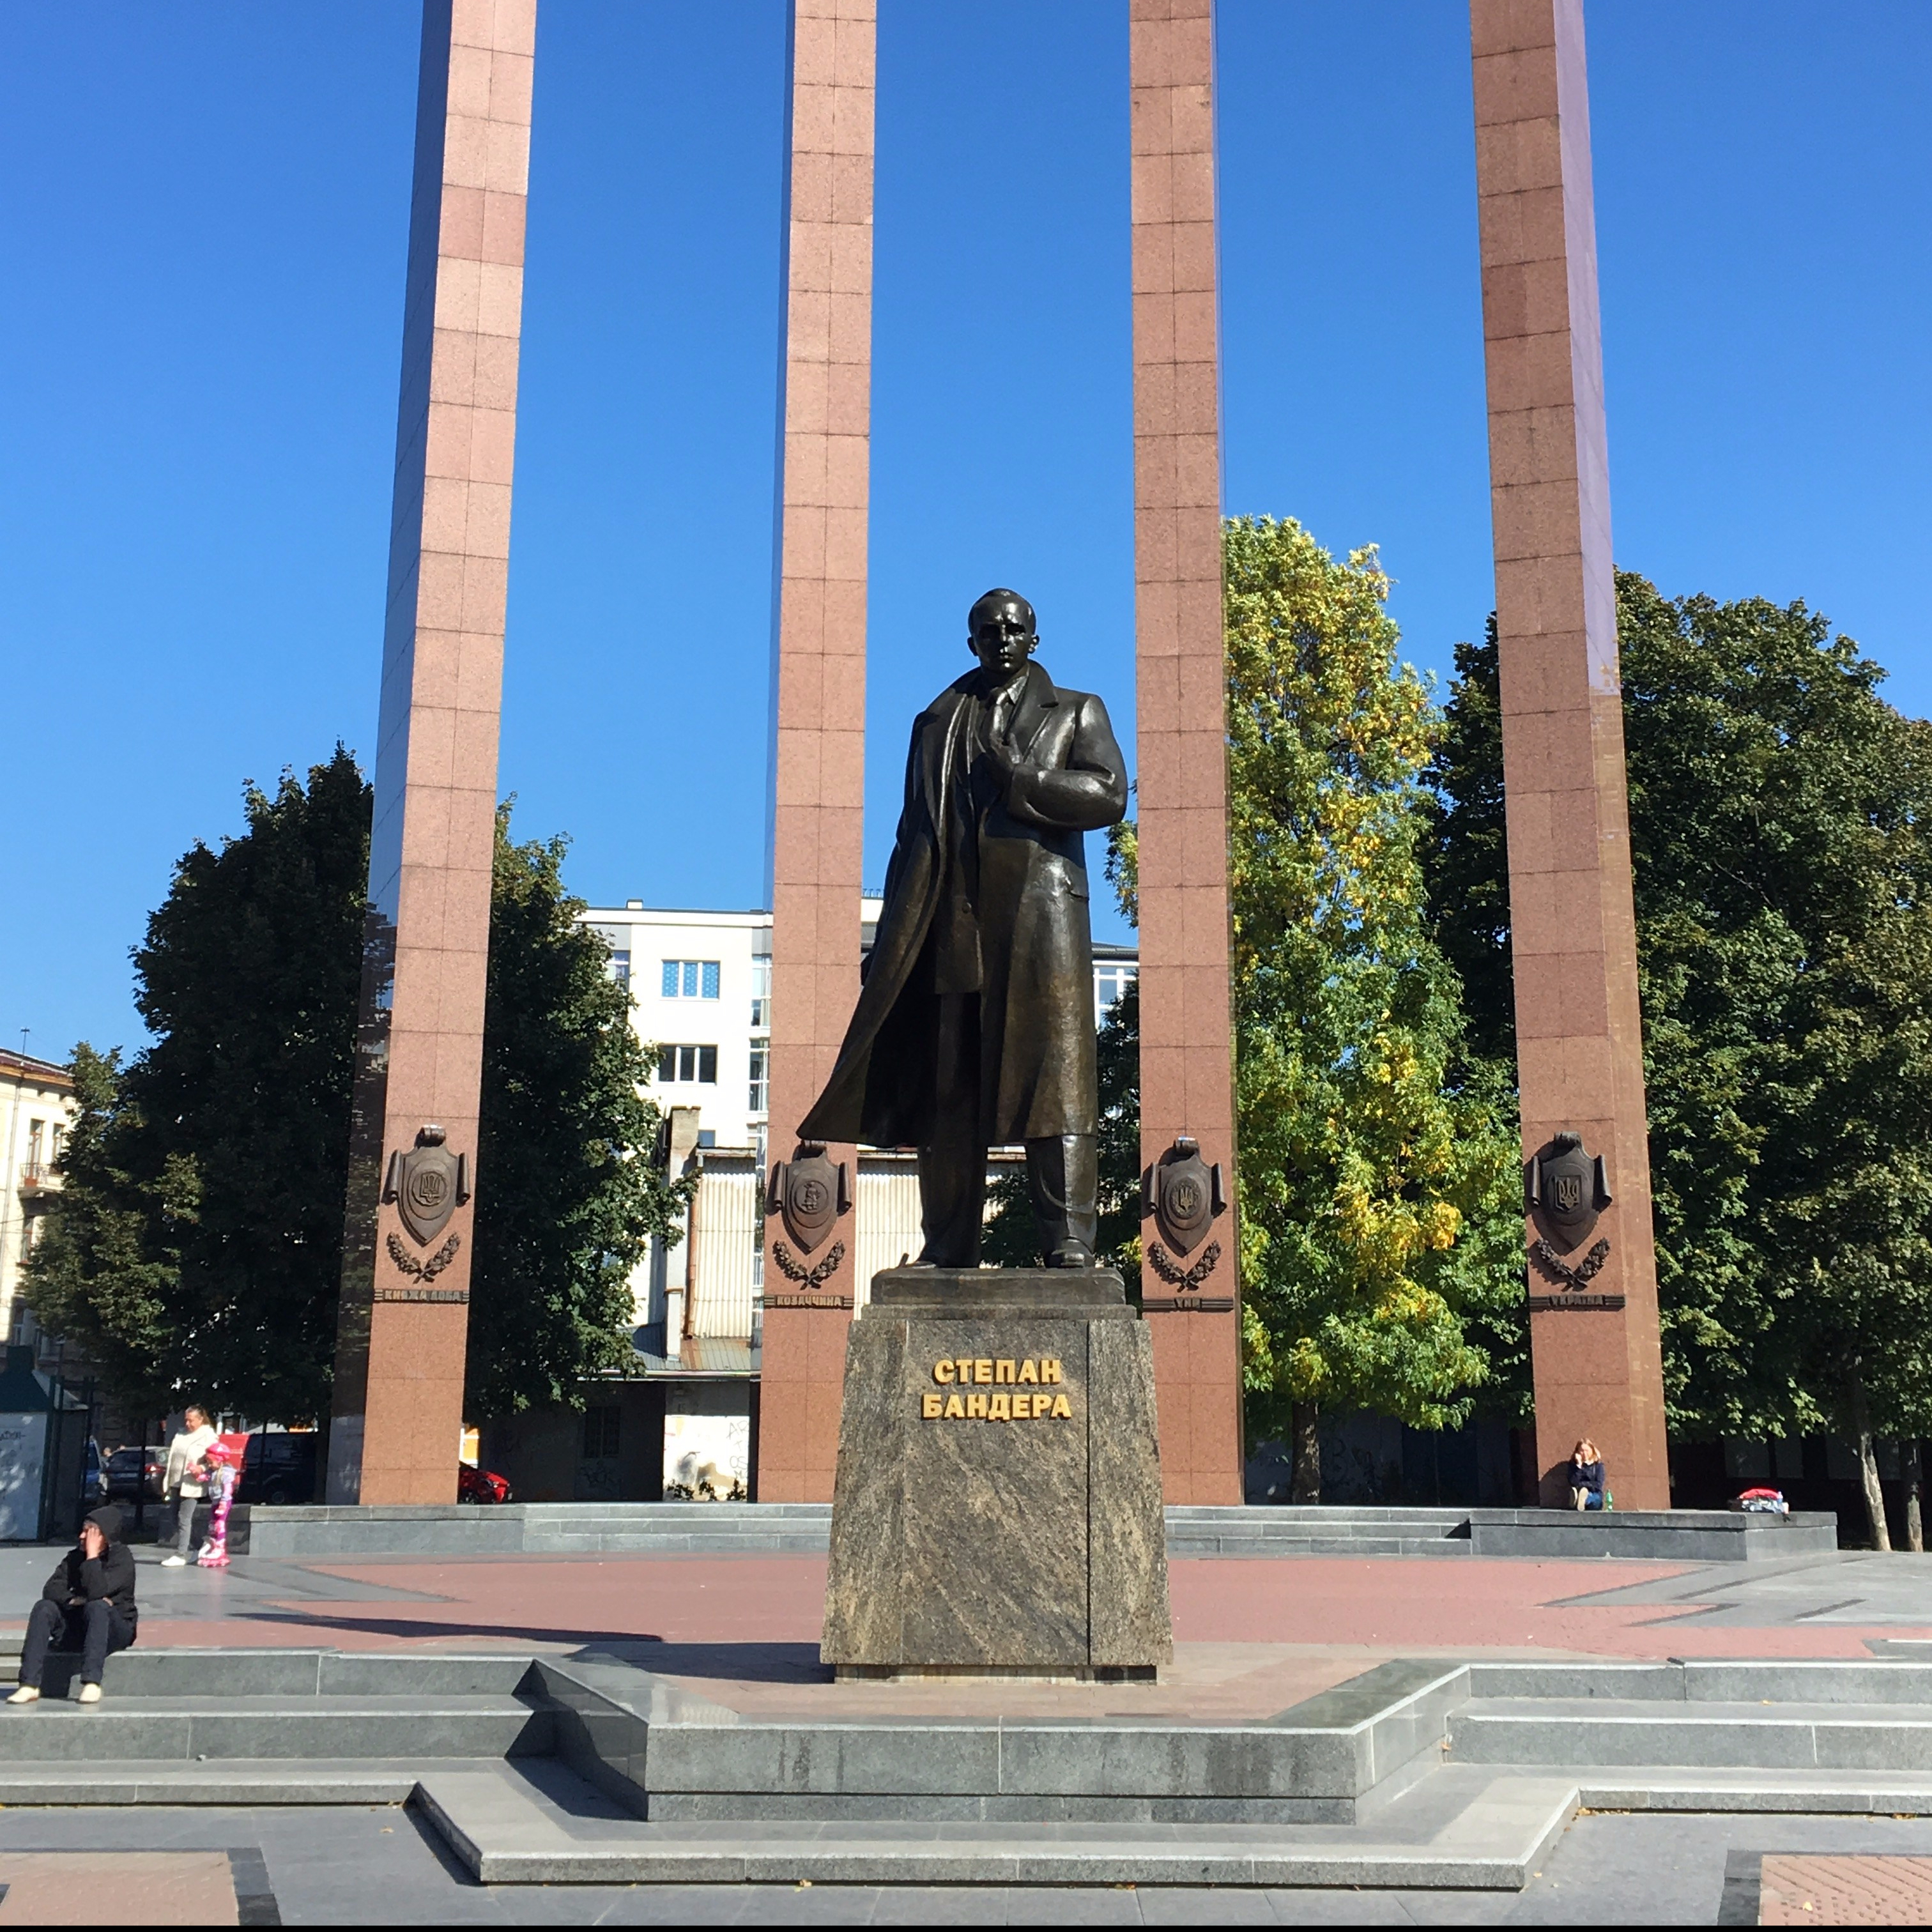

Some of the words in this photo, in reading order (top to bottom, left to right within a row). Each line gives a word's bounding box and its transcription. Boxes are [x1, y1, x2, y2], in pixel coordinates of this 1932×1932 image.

[776, 1296, 842, 1306] КОЗАЧЧИНА
[933, 1359, 1061, 1384] СТЕПАН
[922, 1393, 1072, 1421] БАНДЕРА
